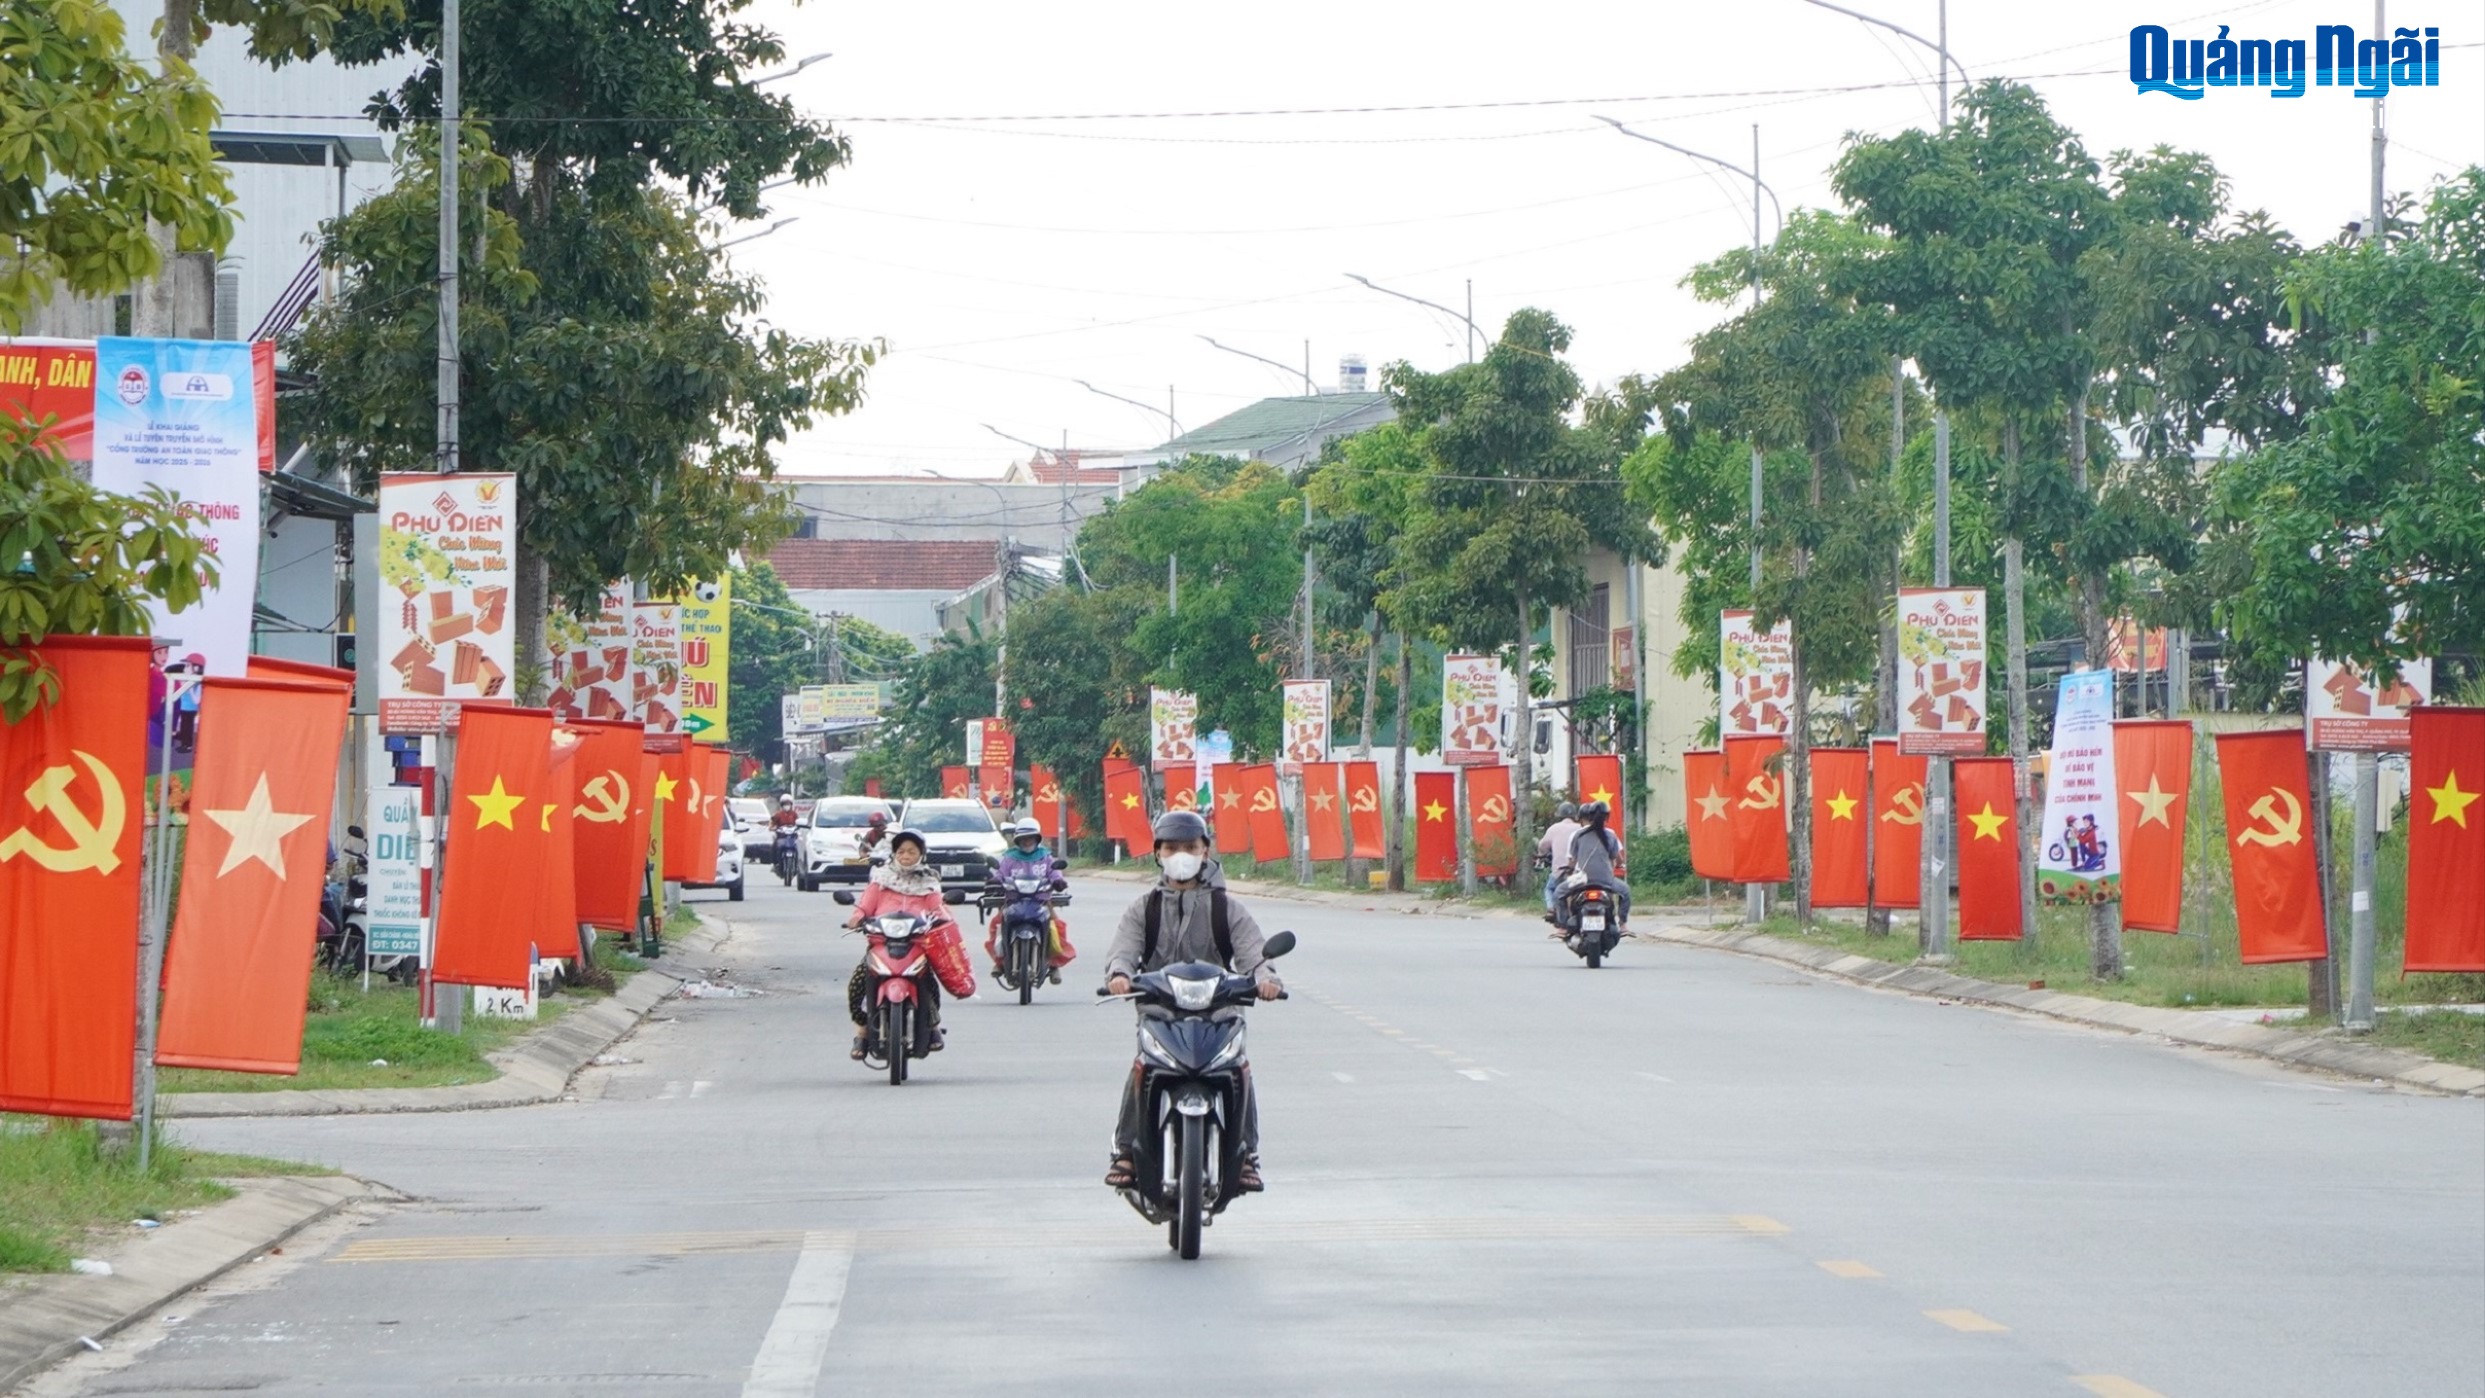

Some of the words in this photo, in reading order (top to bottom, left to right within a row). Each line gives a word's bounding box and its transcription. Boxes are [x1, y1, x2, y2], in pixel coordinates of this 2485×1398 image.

[47, 352, 93, 388] DÂN
[198, 501, 240, 520] THÔNG
[486, 997, 494, 1014] 2
[501, 997, 524, 1014] Km
